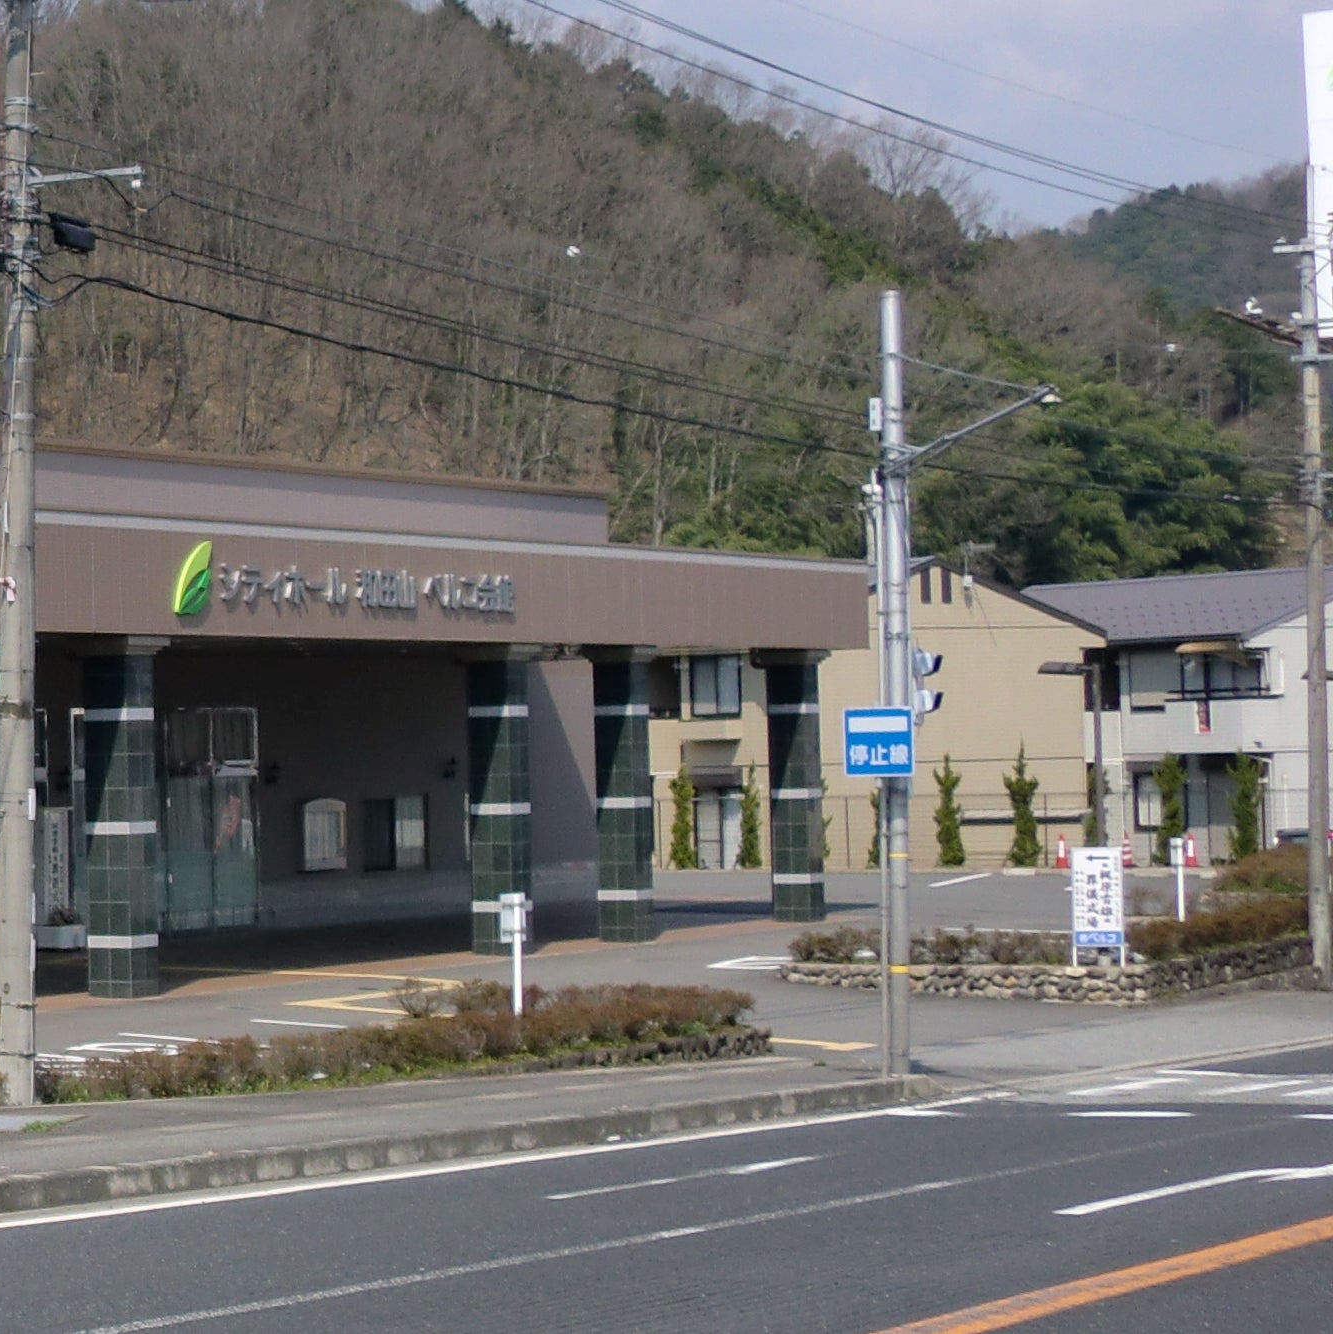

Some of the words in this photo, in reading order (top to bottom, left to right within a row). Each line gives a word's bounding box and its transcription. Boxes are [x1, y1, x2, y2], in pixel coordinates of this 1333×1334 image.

[218, 562, 347, 605] シティホール
[354, 567, 418, 610] 和田山
[422, 572, 516, 614] ベルコ会館
[849, 744, 909, 766] 停止線
